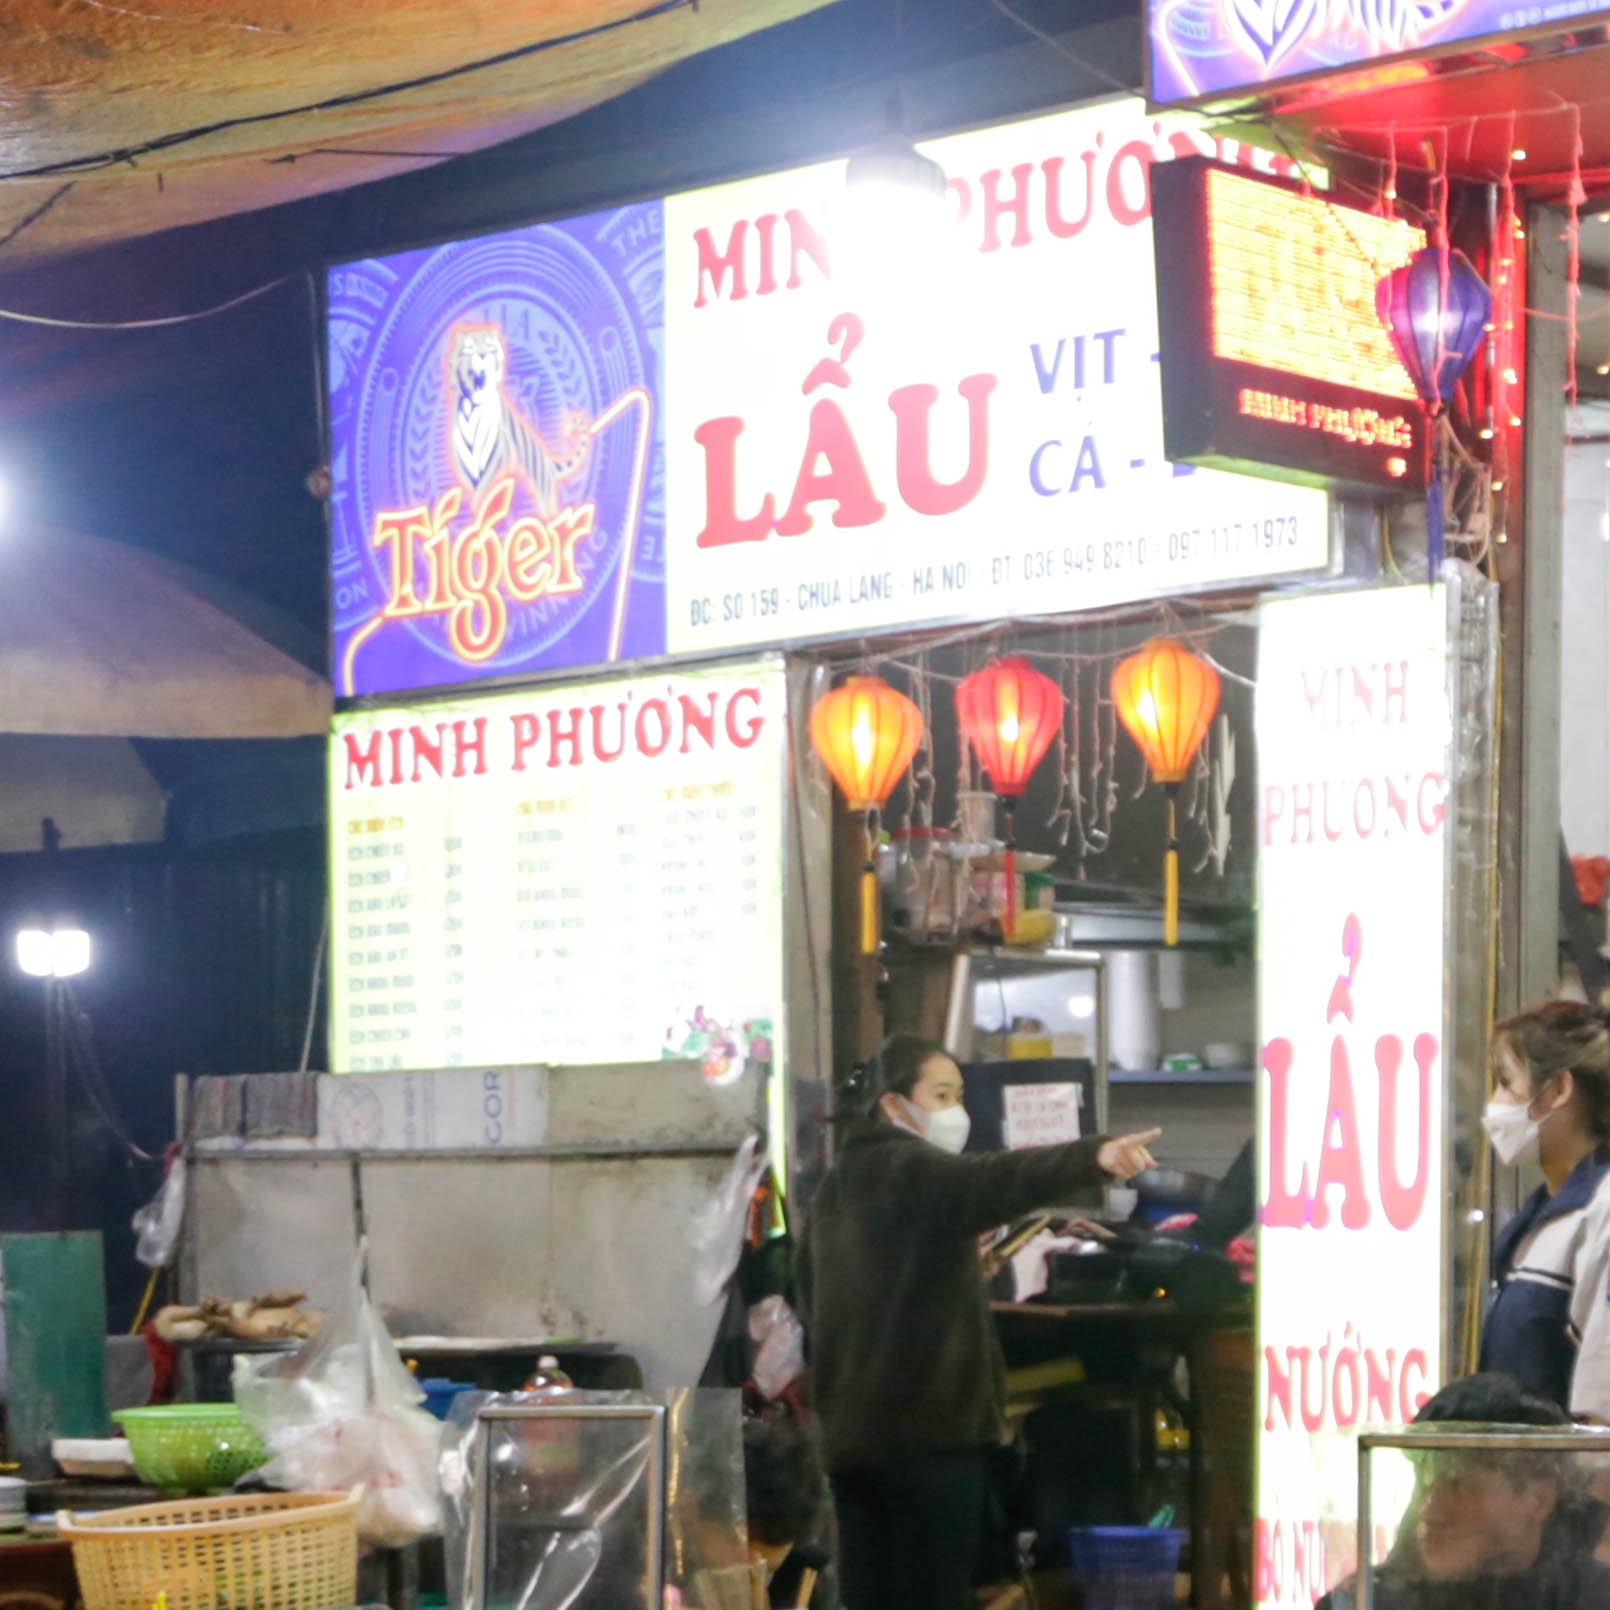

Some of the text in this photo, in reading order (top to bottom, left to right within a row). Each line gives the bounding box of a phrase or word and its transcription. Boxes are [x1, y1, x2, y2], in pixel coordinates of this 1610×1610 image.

[694, 312, 1000, 549] LẨU
[374, 477, 596, 664] Tiger
[752, 588, 780, 616] 159
[343, 684, 766, 790] MINH PHƯƠNG
[1265, 1322, 1433, 1432] NƯỚNG
